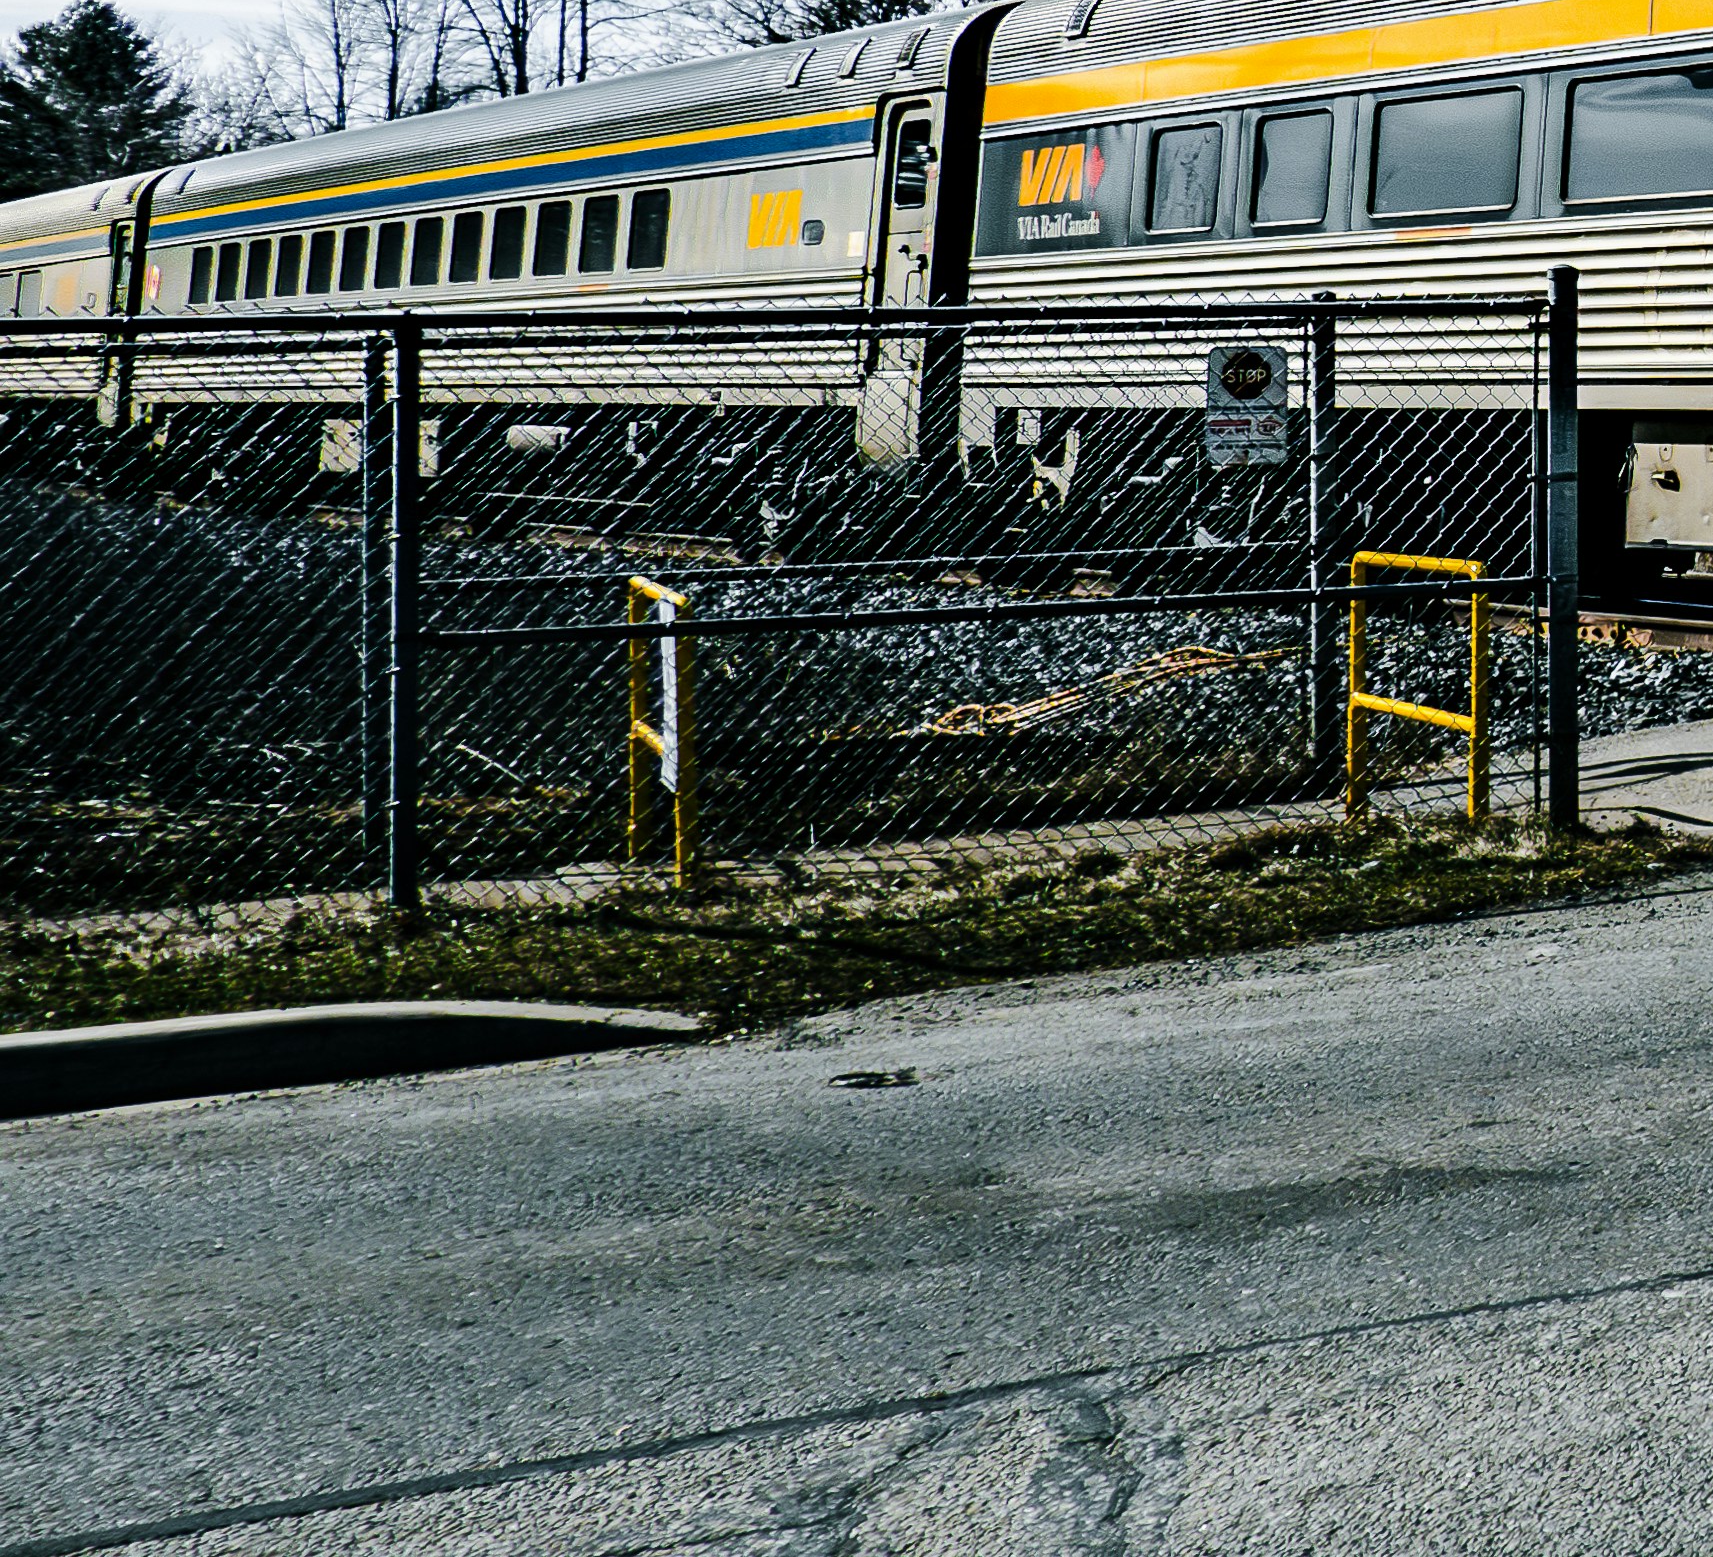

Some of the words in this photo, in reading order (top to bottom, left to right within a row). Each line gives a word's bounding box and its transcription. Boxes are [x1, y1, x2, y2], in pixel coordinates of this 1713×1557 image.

[1018, 143, 1085, 206] VIA
[746, 189, 803, 249] VIA
[1018, 217, 1039, 239] VIA
[1041, 214, 1061, 238] Rail
[1062, 211, 1100, 236] Canada
[1227, 369, 1266, 383] STOP
